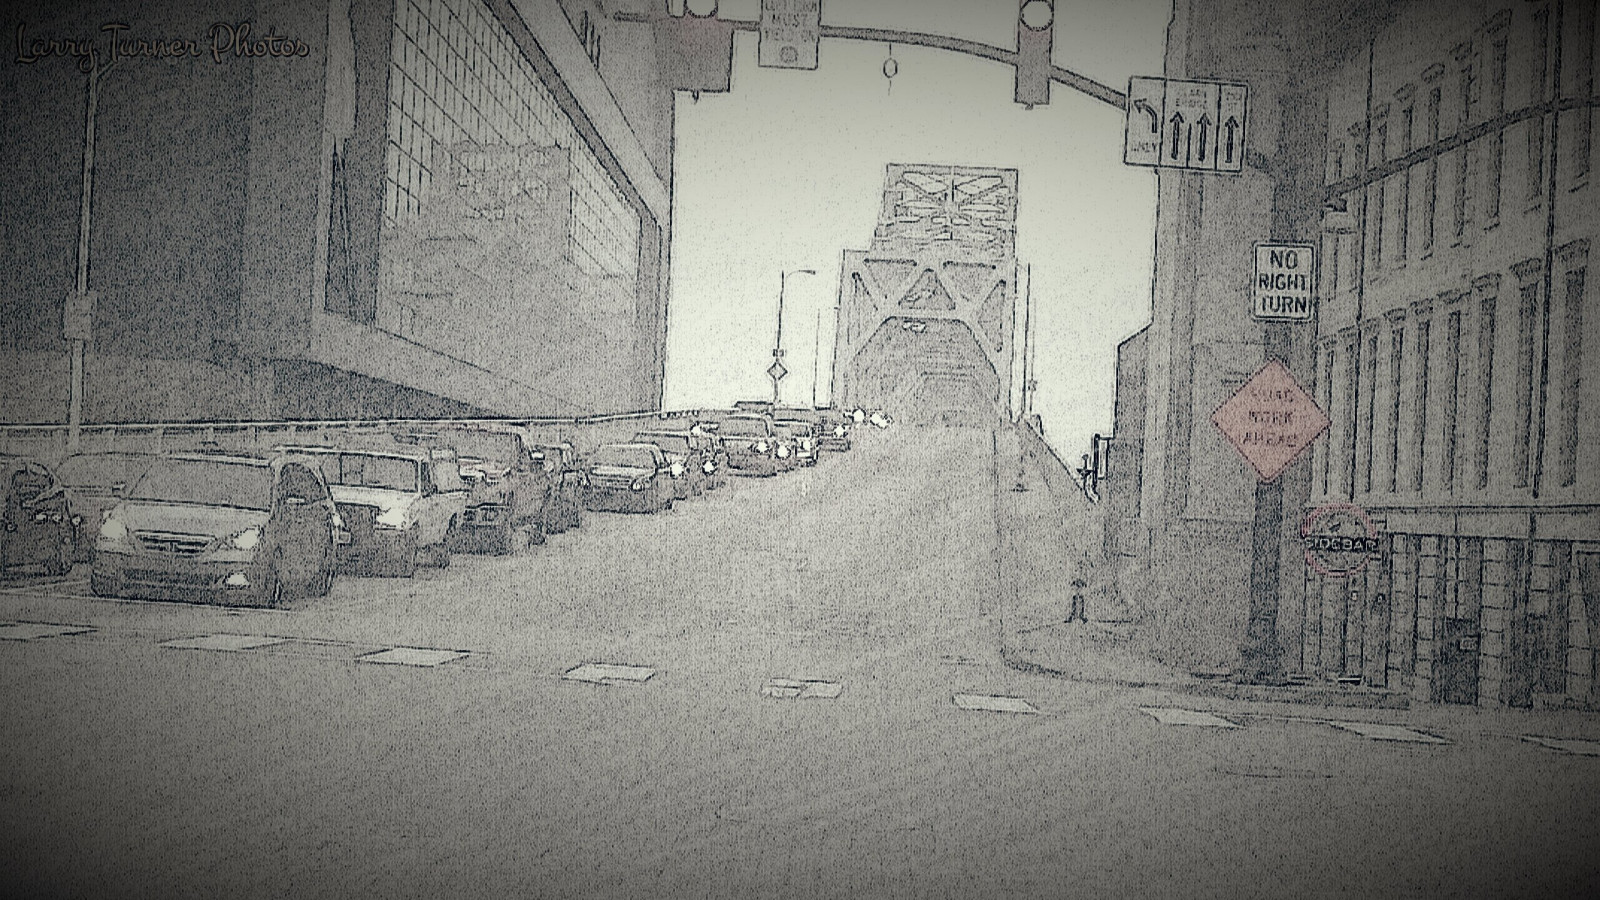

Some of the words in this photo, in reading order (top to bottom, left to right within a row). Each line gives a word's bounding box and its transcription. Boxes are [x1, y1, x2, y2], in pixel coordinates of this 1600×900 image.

[771, 13, 807, 28] MUST
[1269, 249, 1298, 270] NO
[1258, 272, 1308, 291] RIGHT
[1261, 294, 1307, 313] TURN
[1248, 410, 1294, 425] WORK
[1304, 537, 1379, 552] SIDEBAR
